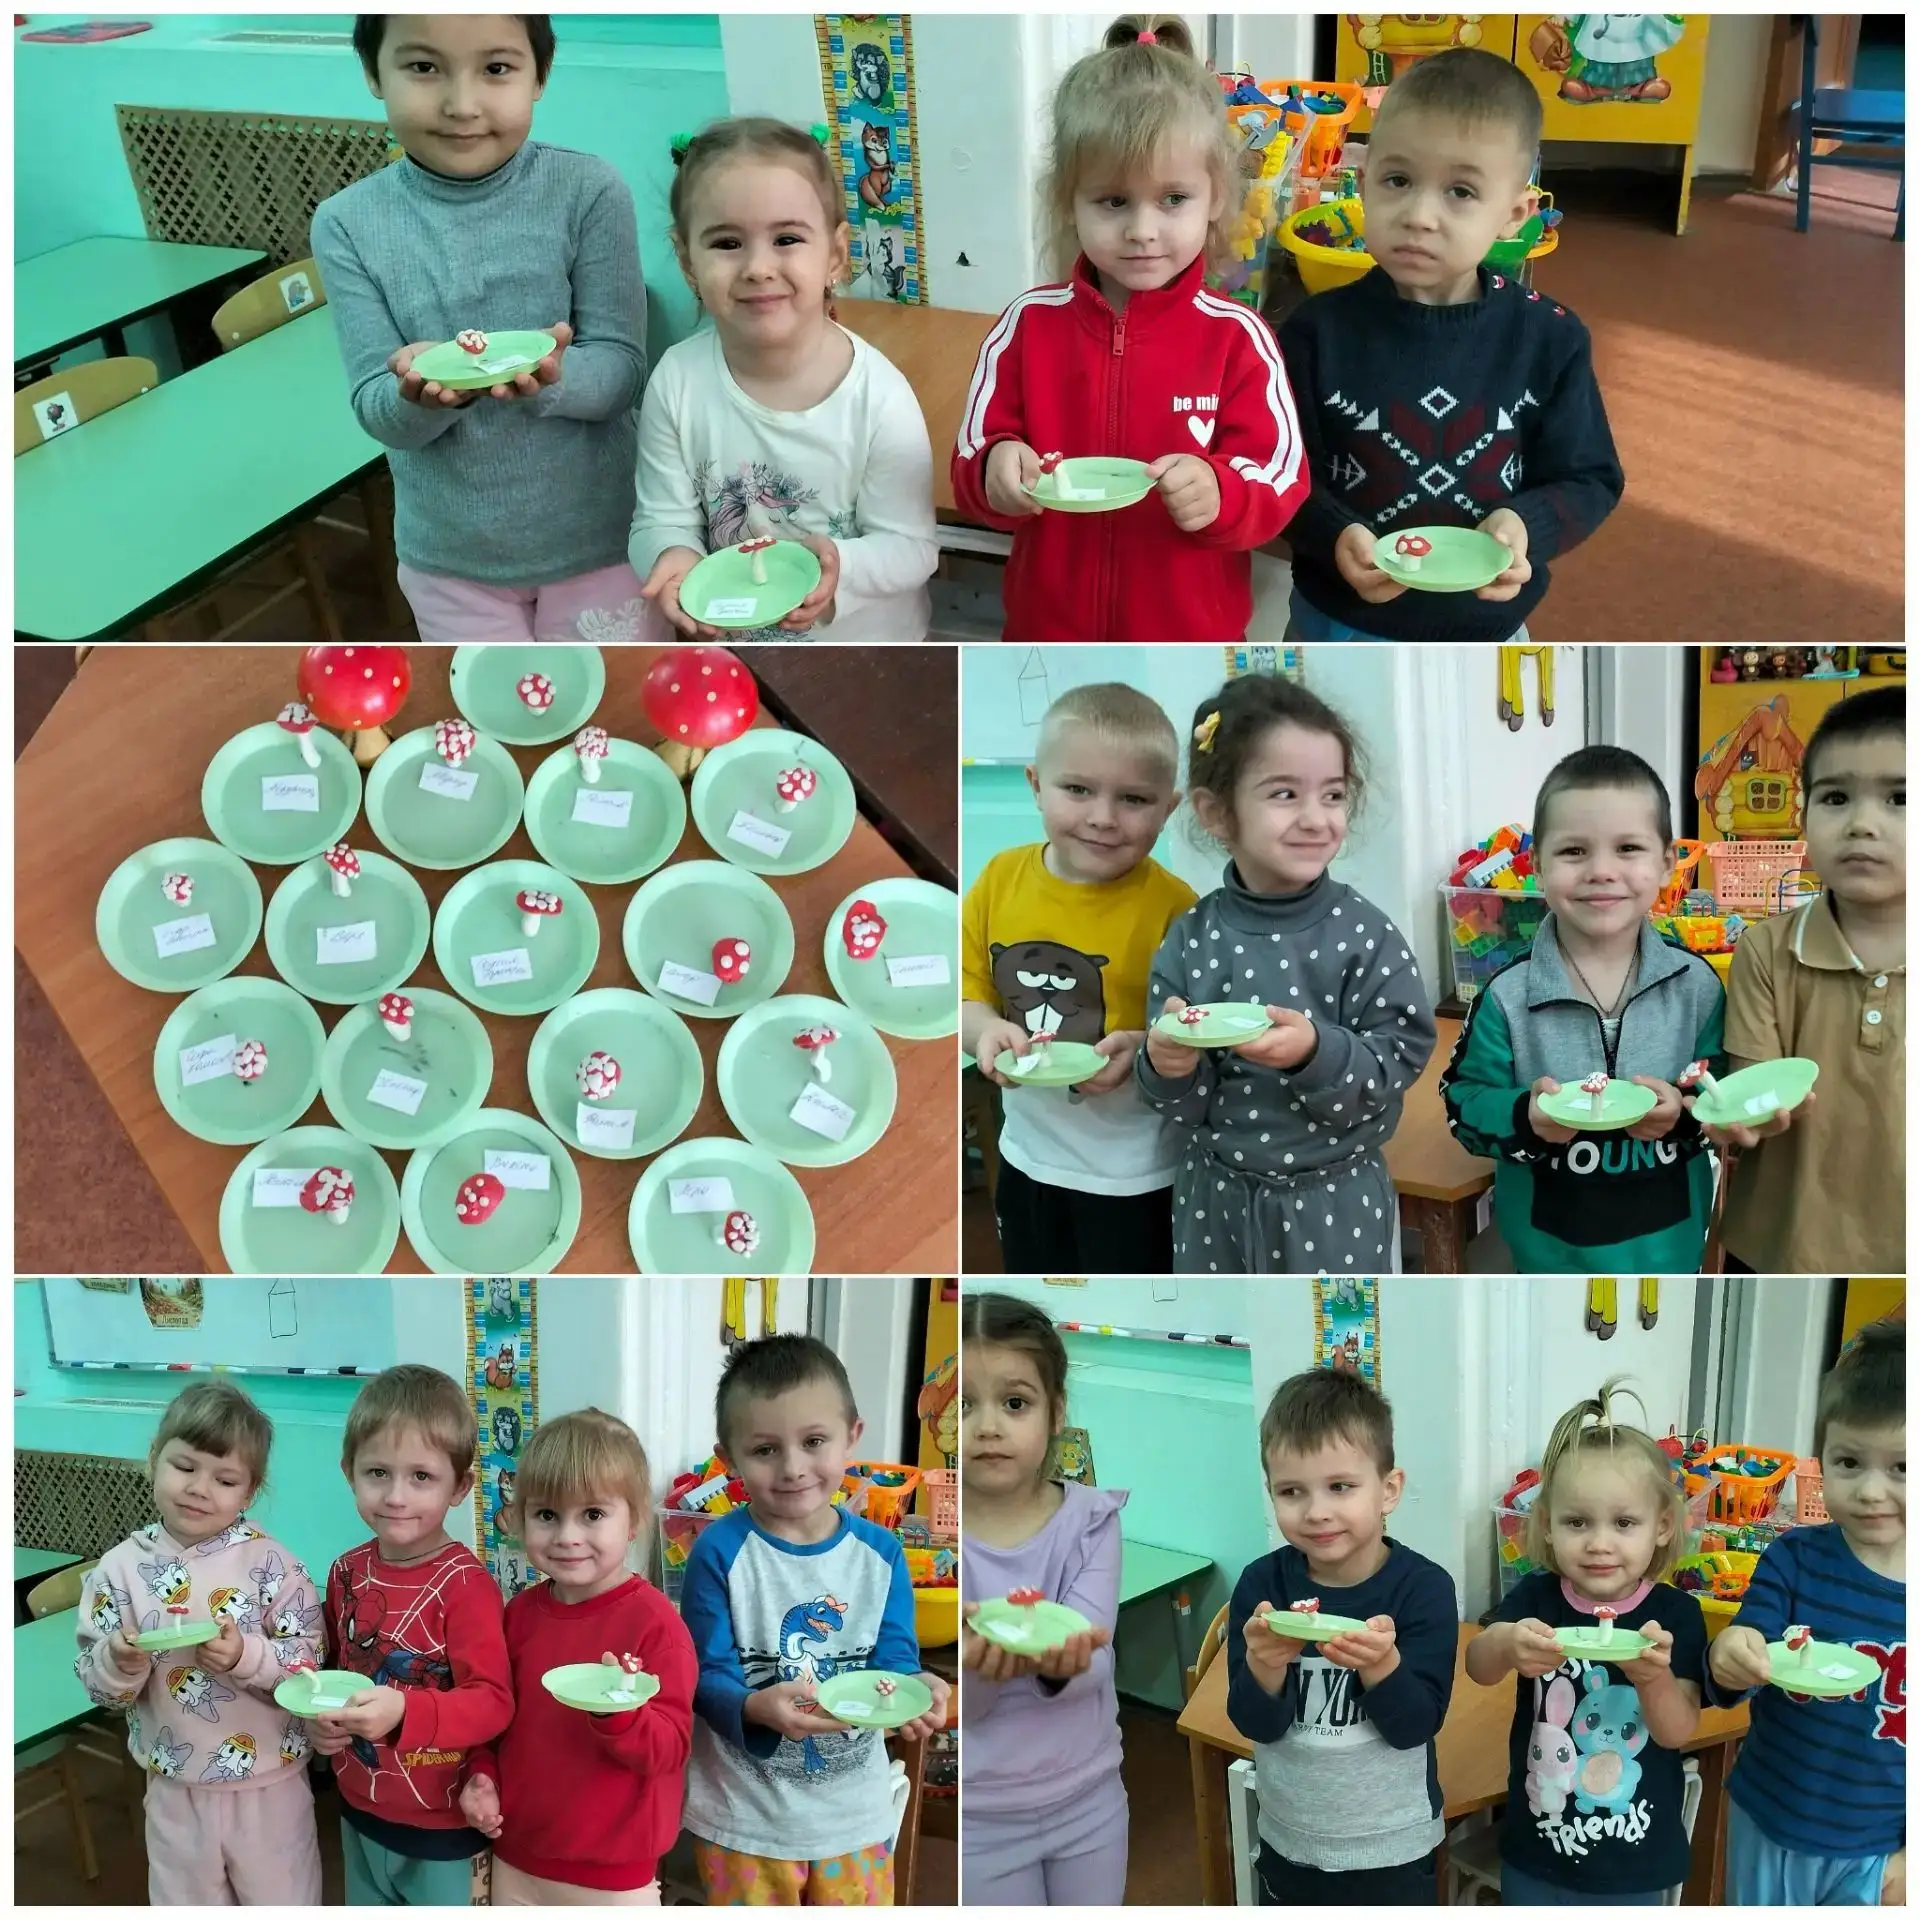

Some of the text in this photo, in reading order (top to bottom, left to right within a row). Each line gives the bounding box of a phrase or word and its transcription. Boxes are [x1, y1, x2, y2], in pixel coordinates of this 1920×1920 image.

[1173, 396, 1193, 412] be
[1550, 1138, 1678, 1175] OUNG
[1315, 1726, 1343, 1736] TEAM
